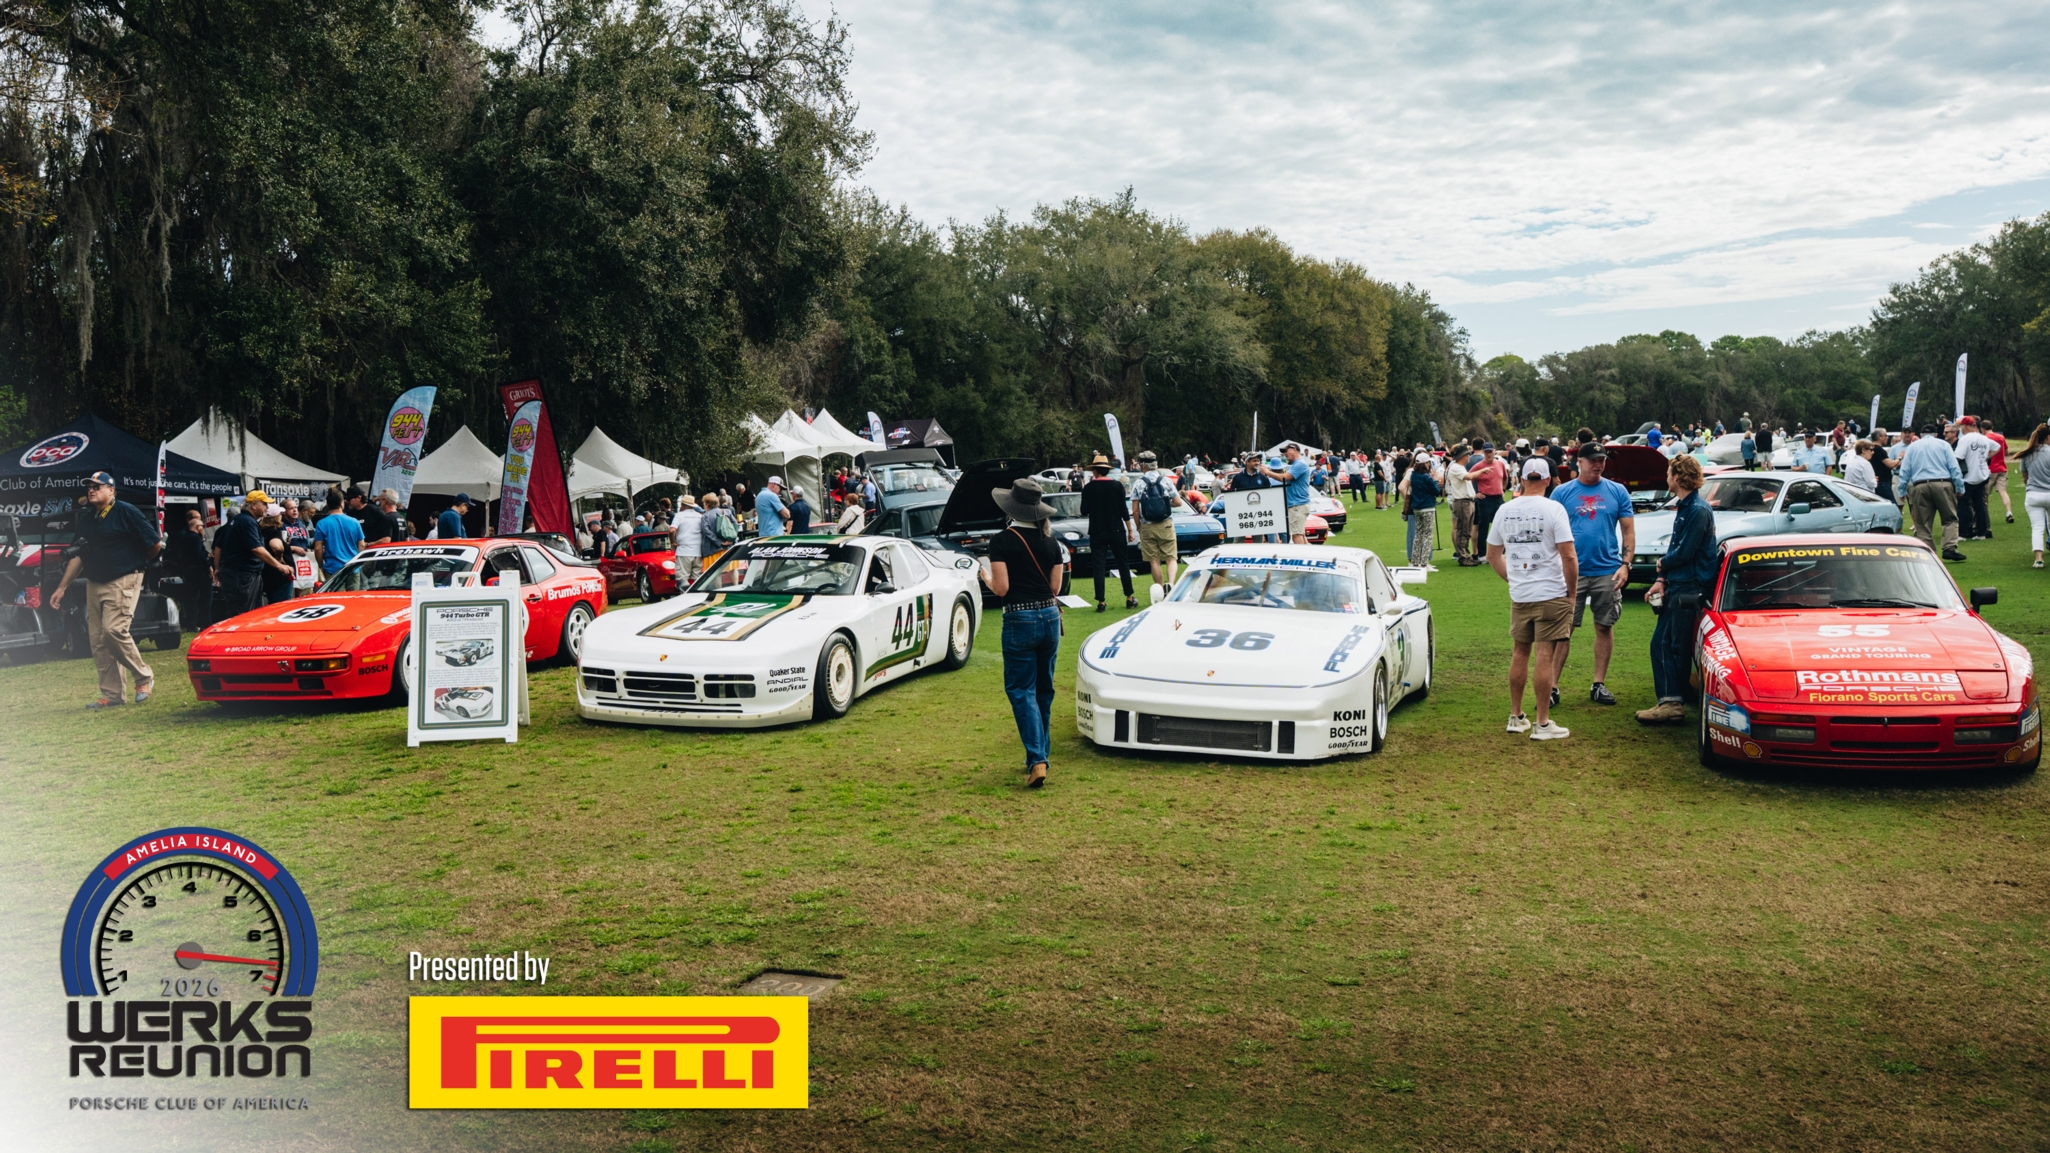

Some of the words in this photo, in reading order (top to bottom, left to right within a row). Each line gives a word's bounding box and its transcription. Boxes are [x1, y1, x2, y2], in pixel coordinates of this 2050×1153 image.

[391, 412, 422, 428] 944
[392, 427, 423, 439] FEST
[511, 424, 532, 438] 944
[0, 478, 27, 491] Club
[30, 476, 41, 489] of
[45, 476, 87, 488] Americ
[124, 476, 134, 486] It's
[136, 478, 147, 487] not
[148, 478, 158, 489] jus
[190, 481, 199, 490] it's
[200, 481, 210, 491] the
[212, 483, 232, 493] people
[259, 480, 310, 497] Transaxle
[1238, 510, 1273, 520] 924/944
[1239, 520, 1274, 529] 968/928
[374, 547, 445, 558] Firehawk
[1737, 548, 1835, 564] Downtown
[1840, 547, 1880, 556] Fine
[1885, 547, 1930, 561] Cars
[1210, 556, 1279, 566] HERMAN
[1280, 558, 1338, 570] MILLER
[548, 585, 581, 600] Brumos
[283, 606, 340, 620] 58
[437, 606, 493, 614] PORSCHE
[673, 617, 737, 635] 44
[891, 603, 914, 650] 44
[1816, 624, 1890, 637] 55
[1185, 628, 1276, 651] 36
[1323, 624, 1370, 673] PORSCHE
[358, 664, 389, 676] BOSCH
[769, 668, 789, 677] Quaker
[790, 666, 806, 675] State
[1796, 669, 1960, 684] Rothmans
[767, 676, 809, 686] ANDIAL
[769, 684, 807, 693] GOODYEAR
[1809, 692, 1864, 703] Fiorano
[1868, 691, 1918, 704] Sports
[1921, 691, 1957, 702] Cars
[1333, 709, 1366, 721] KONI
[1330, 725, 1367, 739] BOSCH
[1709, 727, 1741, 748] Shell
[1328, 739, 1368, 750] GOODYEAR
